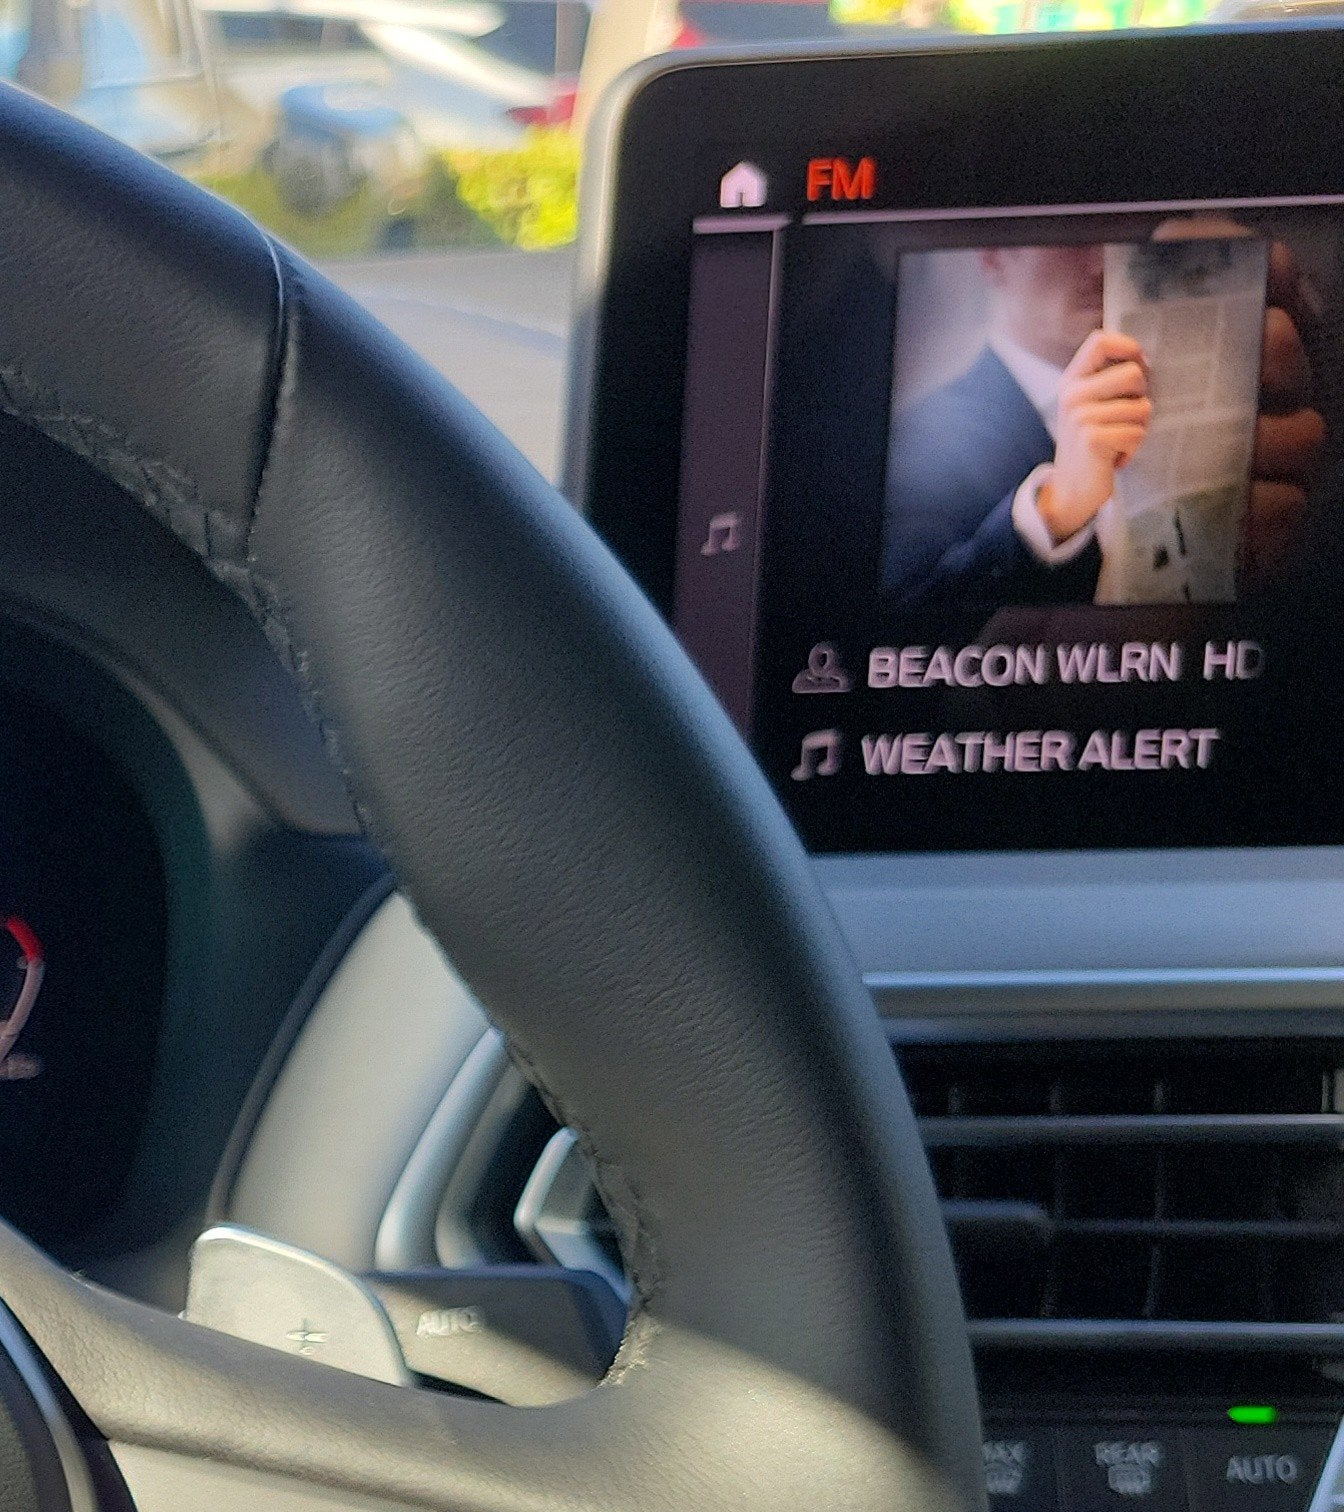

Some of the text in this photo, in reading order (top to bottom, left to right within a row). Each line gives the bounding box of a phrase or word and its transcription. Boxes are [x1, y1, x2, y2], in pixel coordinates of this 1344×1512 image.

[807, 157, 877, 201] FM
[868, 640, 1266, 688] BEACON WLRN HD
[861, 728, 1220, 776] WEATHER ALERT
[1094, 1440, 1161, 1467] REAR
[1226, 1454, 1299, 1485] AUTO
